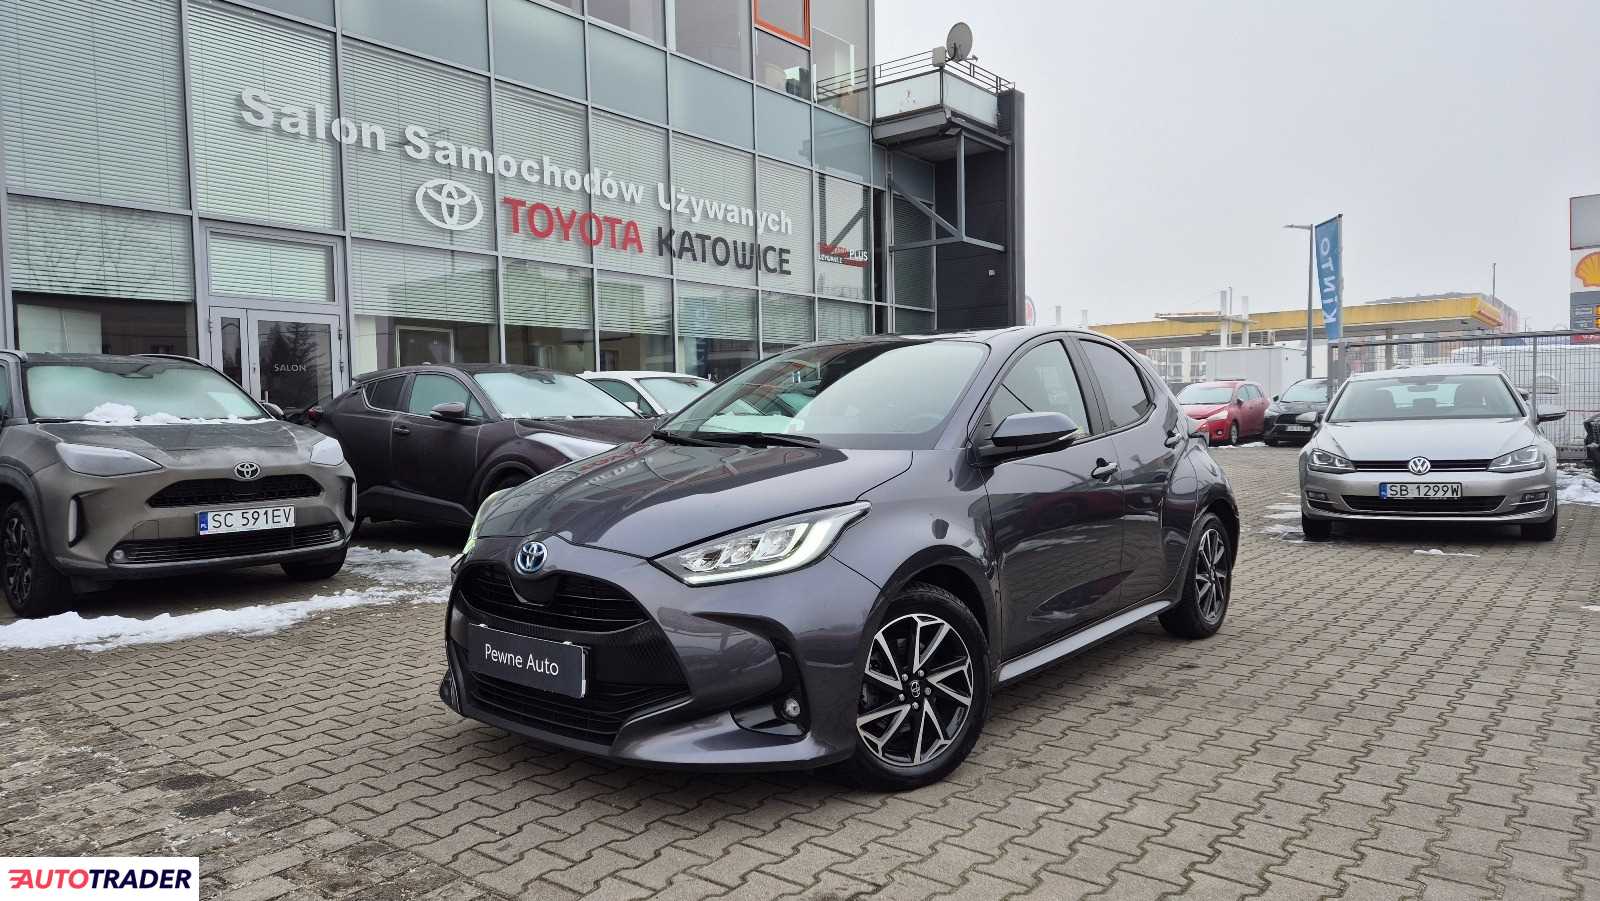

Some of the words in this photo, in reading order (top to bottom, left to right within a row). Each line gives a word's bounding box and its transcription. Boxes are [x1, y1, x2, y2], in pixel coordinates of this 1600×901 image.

[240, 87, 387, 152] Salon
[403, 124, 644, 204] Samochodów
[658, 182, 792, 235] Używanych
[503, 197, 643, 253] TOYOTA
[658, 226, 791, 276] KATOWICE
[850, 248, 869, 261] PLUS
[274, 363, 306, 372] SALON
[1390, 485, 1409, 496] SB
[1416, 485, 1460, 496] 1299W
[212, 513, 233, 529] SC
[242, 508, 291, 527] 591EV
[485, 643, 523, 668] Pewne
[527, 654, 559, 676] Auto
